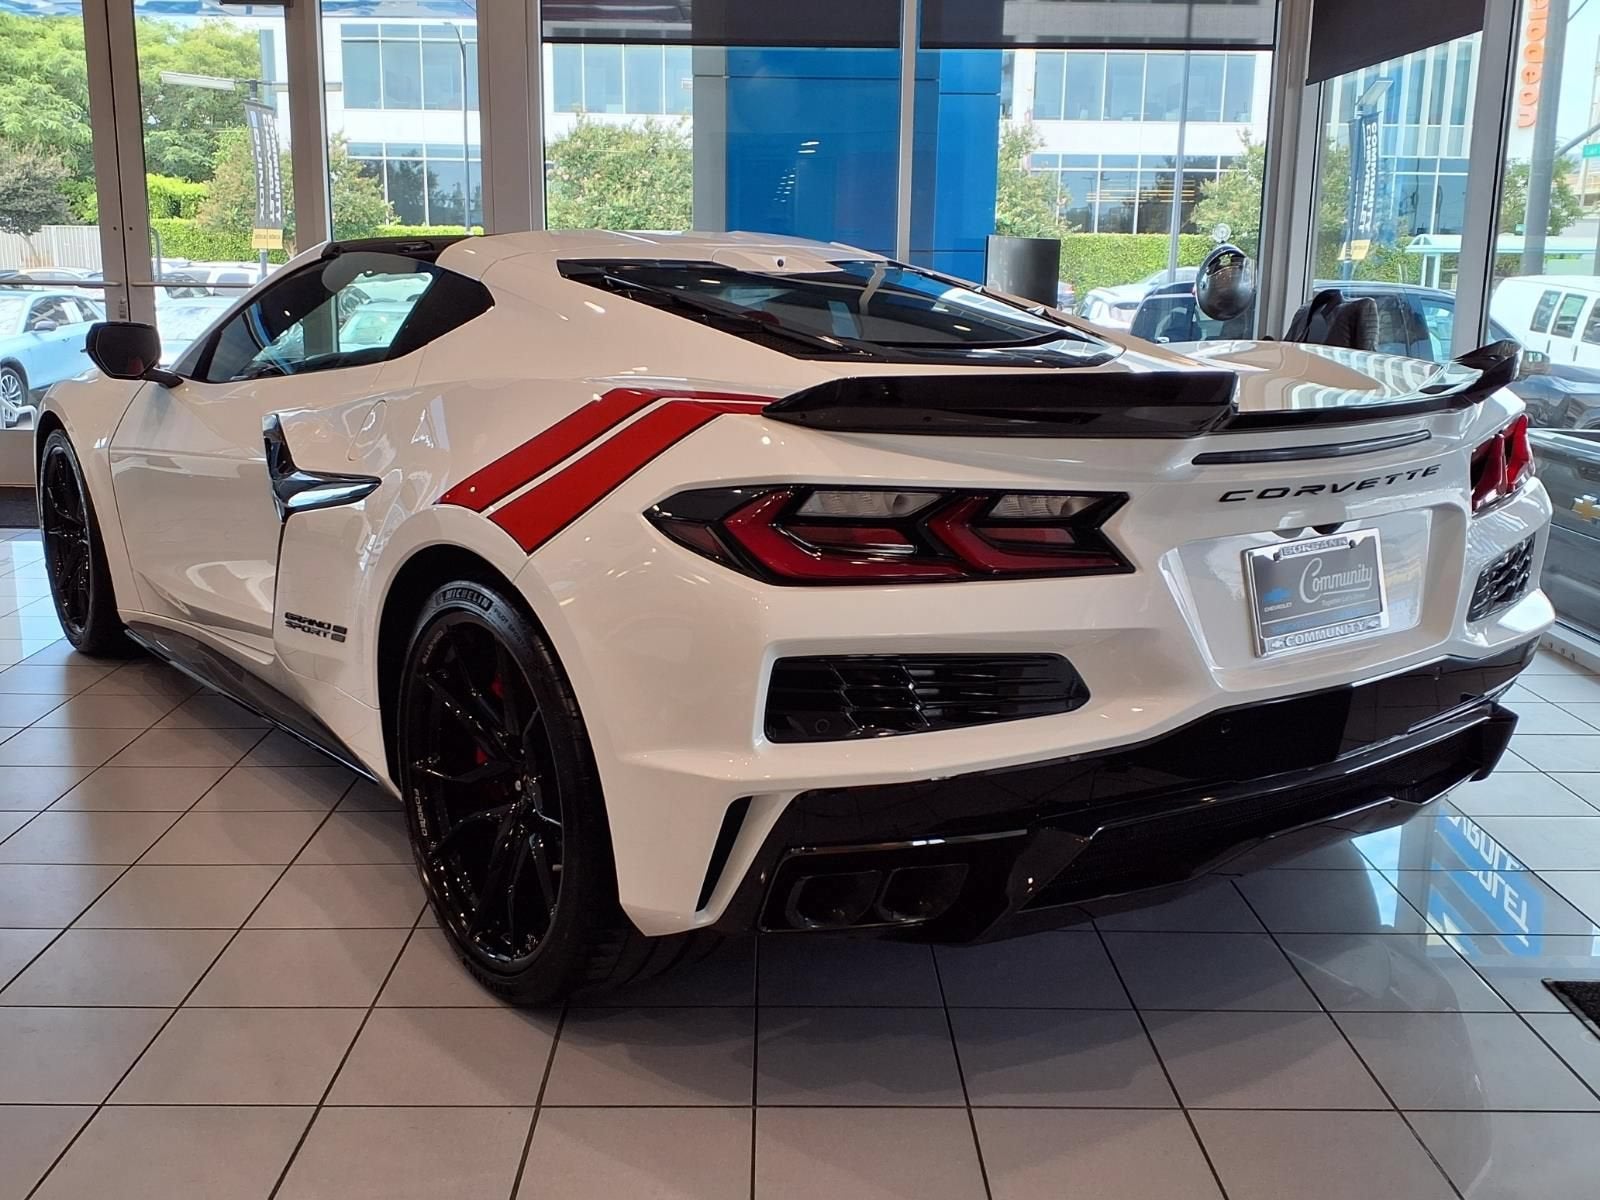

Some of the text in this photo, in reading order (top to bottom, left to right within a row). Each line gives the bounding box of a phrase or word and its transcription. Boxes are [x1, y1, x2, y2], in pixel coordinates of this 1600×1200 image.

[262, 113, 275, 222] CHEVROLET
[268, 113, 281, 220] COMMUNITY
[1359, 124, 1372, 233] CHEVROLET
[1365, 122, 1377, 232] COMMUNITY
[1218, 463, 1441, 502] CORVETTE
[445, 588, 490, 608] MICHELIN
[1299, 557, 1373, 603] Community
[284, 611, 331, 630] GRAND
[284, 620, 331, 638] SPORT
[1285, 620, 1365, 647] COMMUNITY
